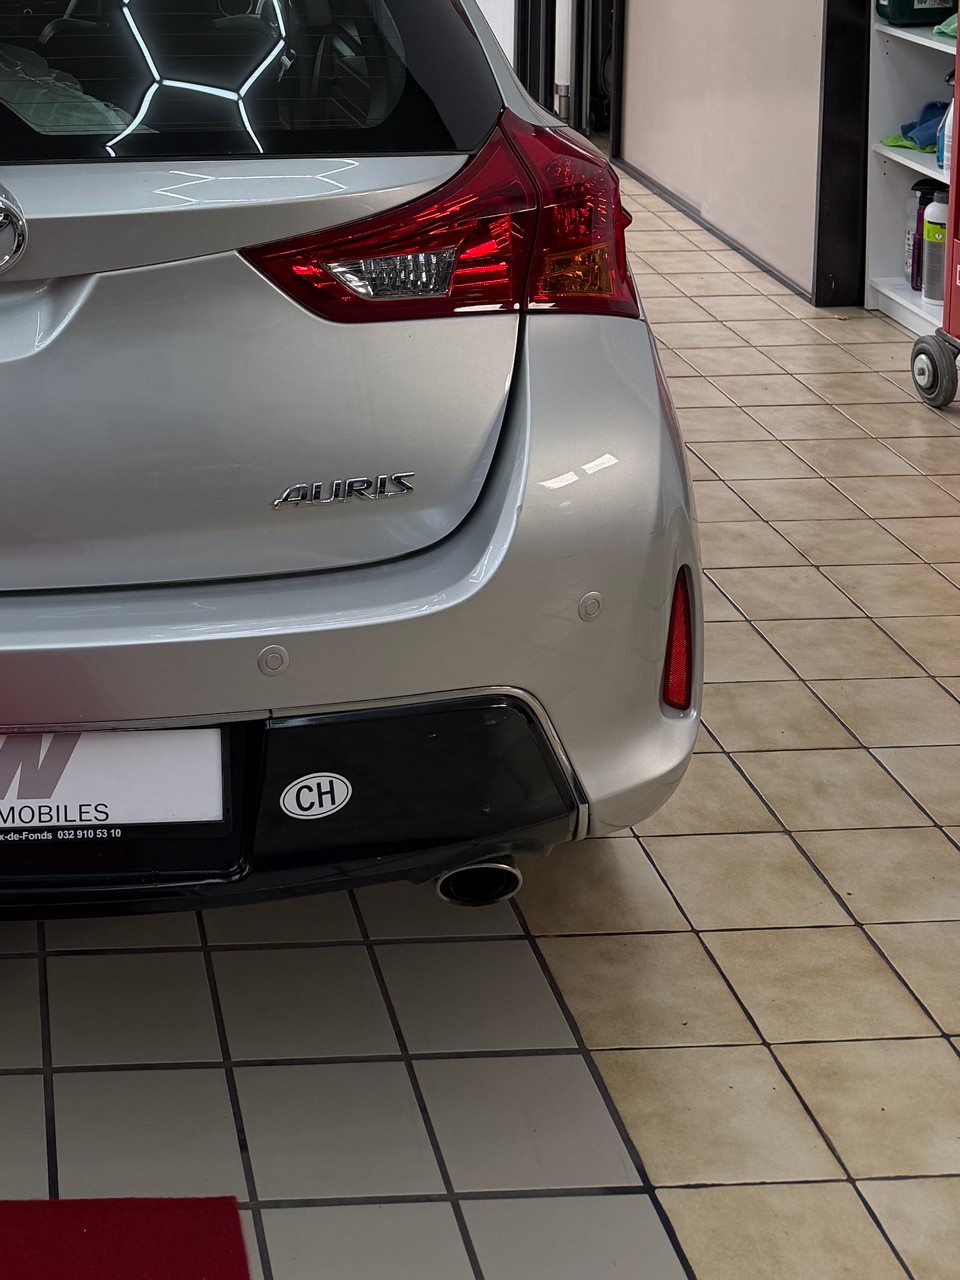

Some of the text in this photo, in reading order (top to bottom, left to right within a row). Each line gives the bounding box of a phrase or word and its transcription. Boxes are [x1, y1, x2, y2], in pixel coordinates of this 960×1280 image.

[272, 471, 415, 510] AURIS
[295, 779, 336, 812] CH
[57, 830, 75, 839] 032
[76, 829, 94, 839] 910
[96, 829, 108, 838] 53
[110, 828, 121, 838] 10
